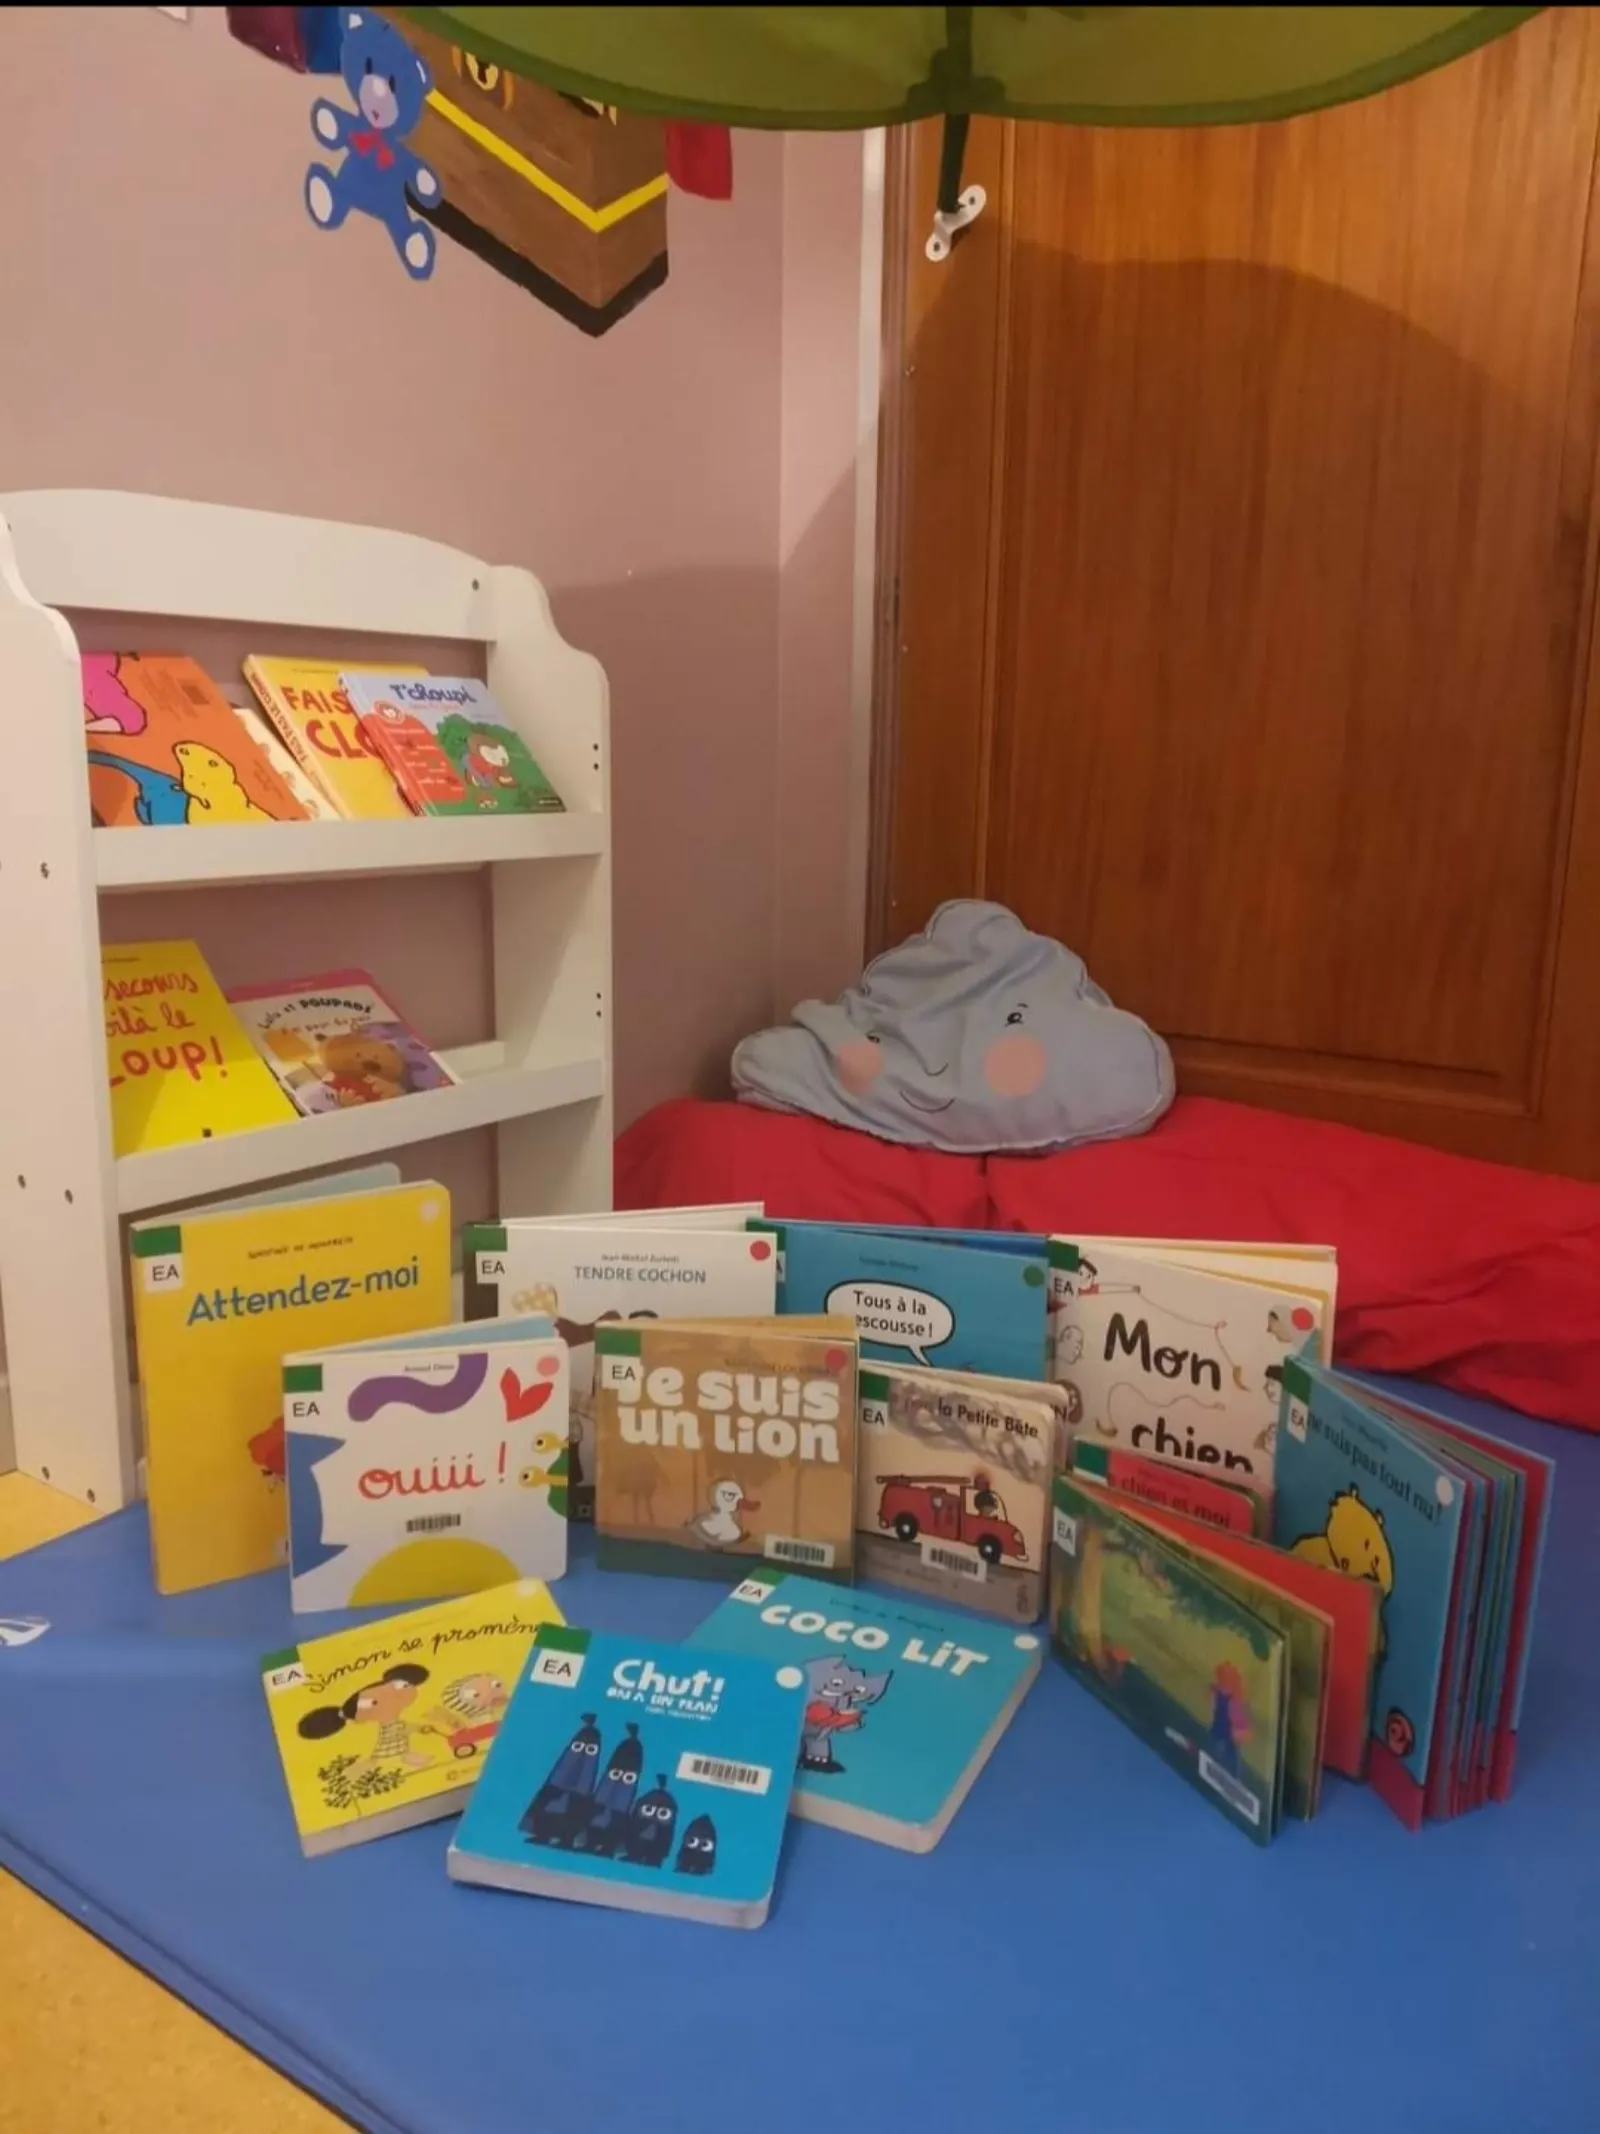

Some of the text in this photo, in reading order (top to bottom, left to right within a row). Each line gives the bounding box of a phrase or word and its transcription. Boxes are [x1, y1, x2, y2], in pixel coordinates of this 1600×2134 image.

[281, 685, 354, 715] FAIS
[306, 719, 382, 758] CL
[106, 1002, 195, 1037] oilà le
[151, 1264, 179, 1281] EA
[482, 1260, 506, 1274] EA
[574, 1266, 707, 1283] TENDRE COCHON
[186, 1256, 420, 1326] Attendez-moi
[1053, 1277, 1075, 1297] EA
[853, 1289, 927, 1316] Tous à la
[856, 1314, 925, 1337] escousse
[1104, 1312, 1222, 1391] Mon
[612, 1365, 636, 1381] EA
[697, 1371, 840, 1422] suis
[293, 1402, 320, 1417] EA
[863, 1410, 885, 1425] EA
[938, 1397, 1039, 1438] la Petite Bête
[1291, 1411, 1305, 1429] EA
[617, 1406, 840, 1463] un lion
[1324, 1424, 1352, 1457] suis
[1351, 1444, 1378, 1477] pas
[1379, 1463, 1410, 1503] tout
[1056, 1518, 1074, 1541] EA
[738, 1583, 762, 1599] EA
[431, 1614, 540, 1656] promèn
[760, 1604, 889, 1650] COCO
[272, 1669, 302, 1686] EA
[543, 1659, 572, 1677] EA
